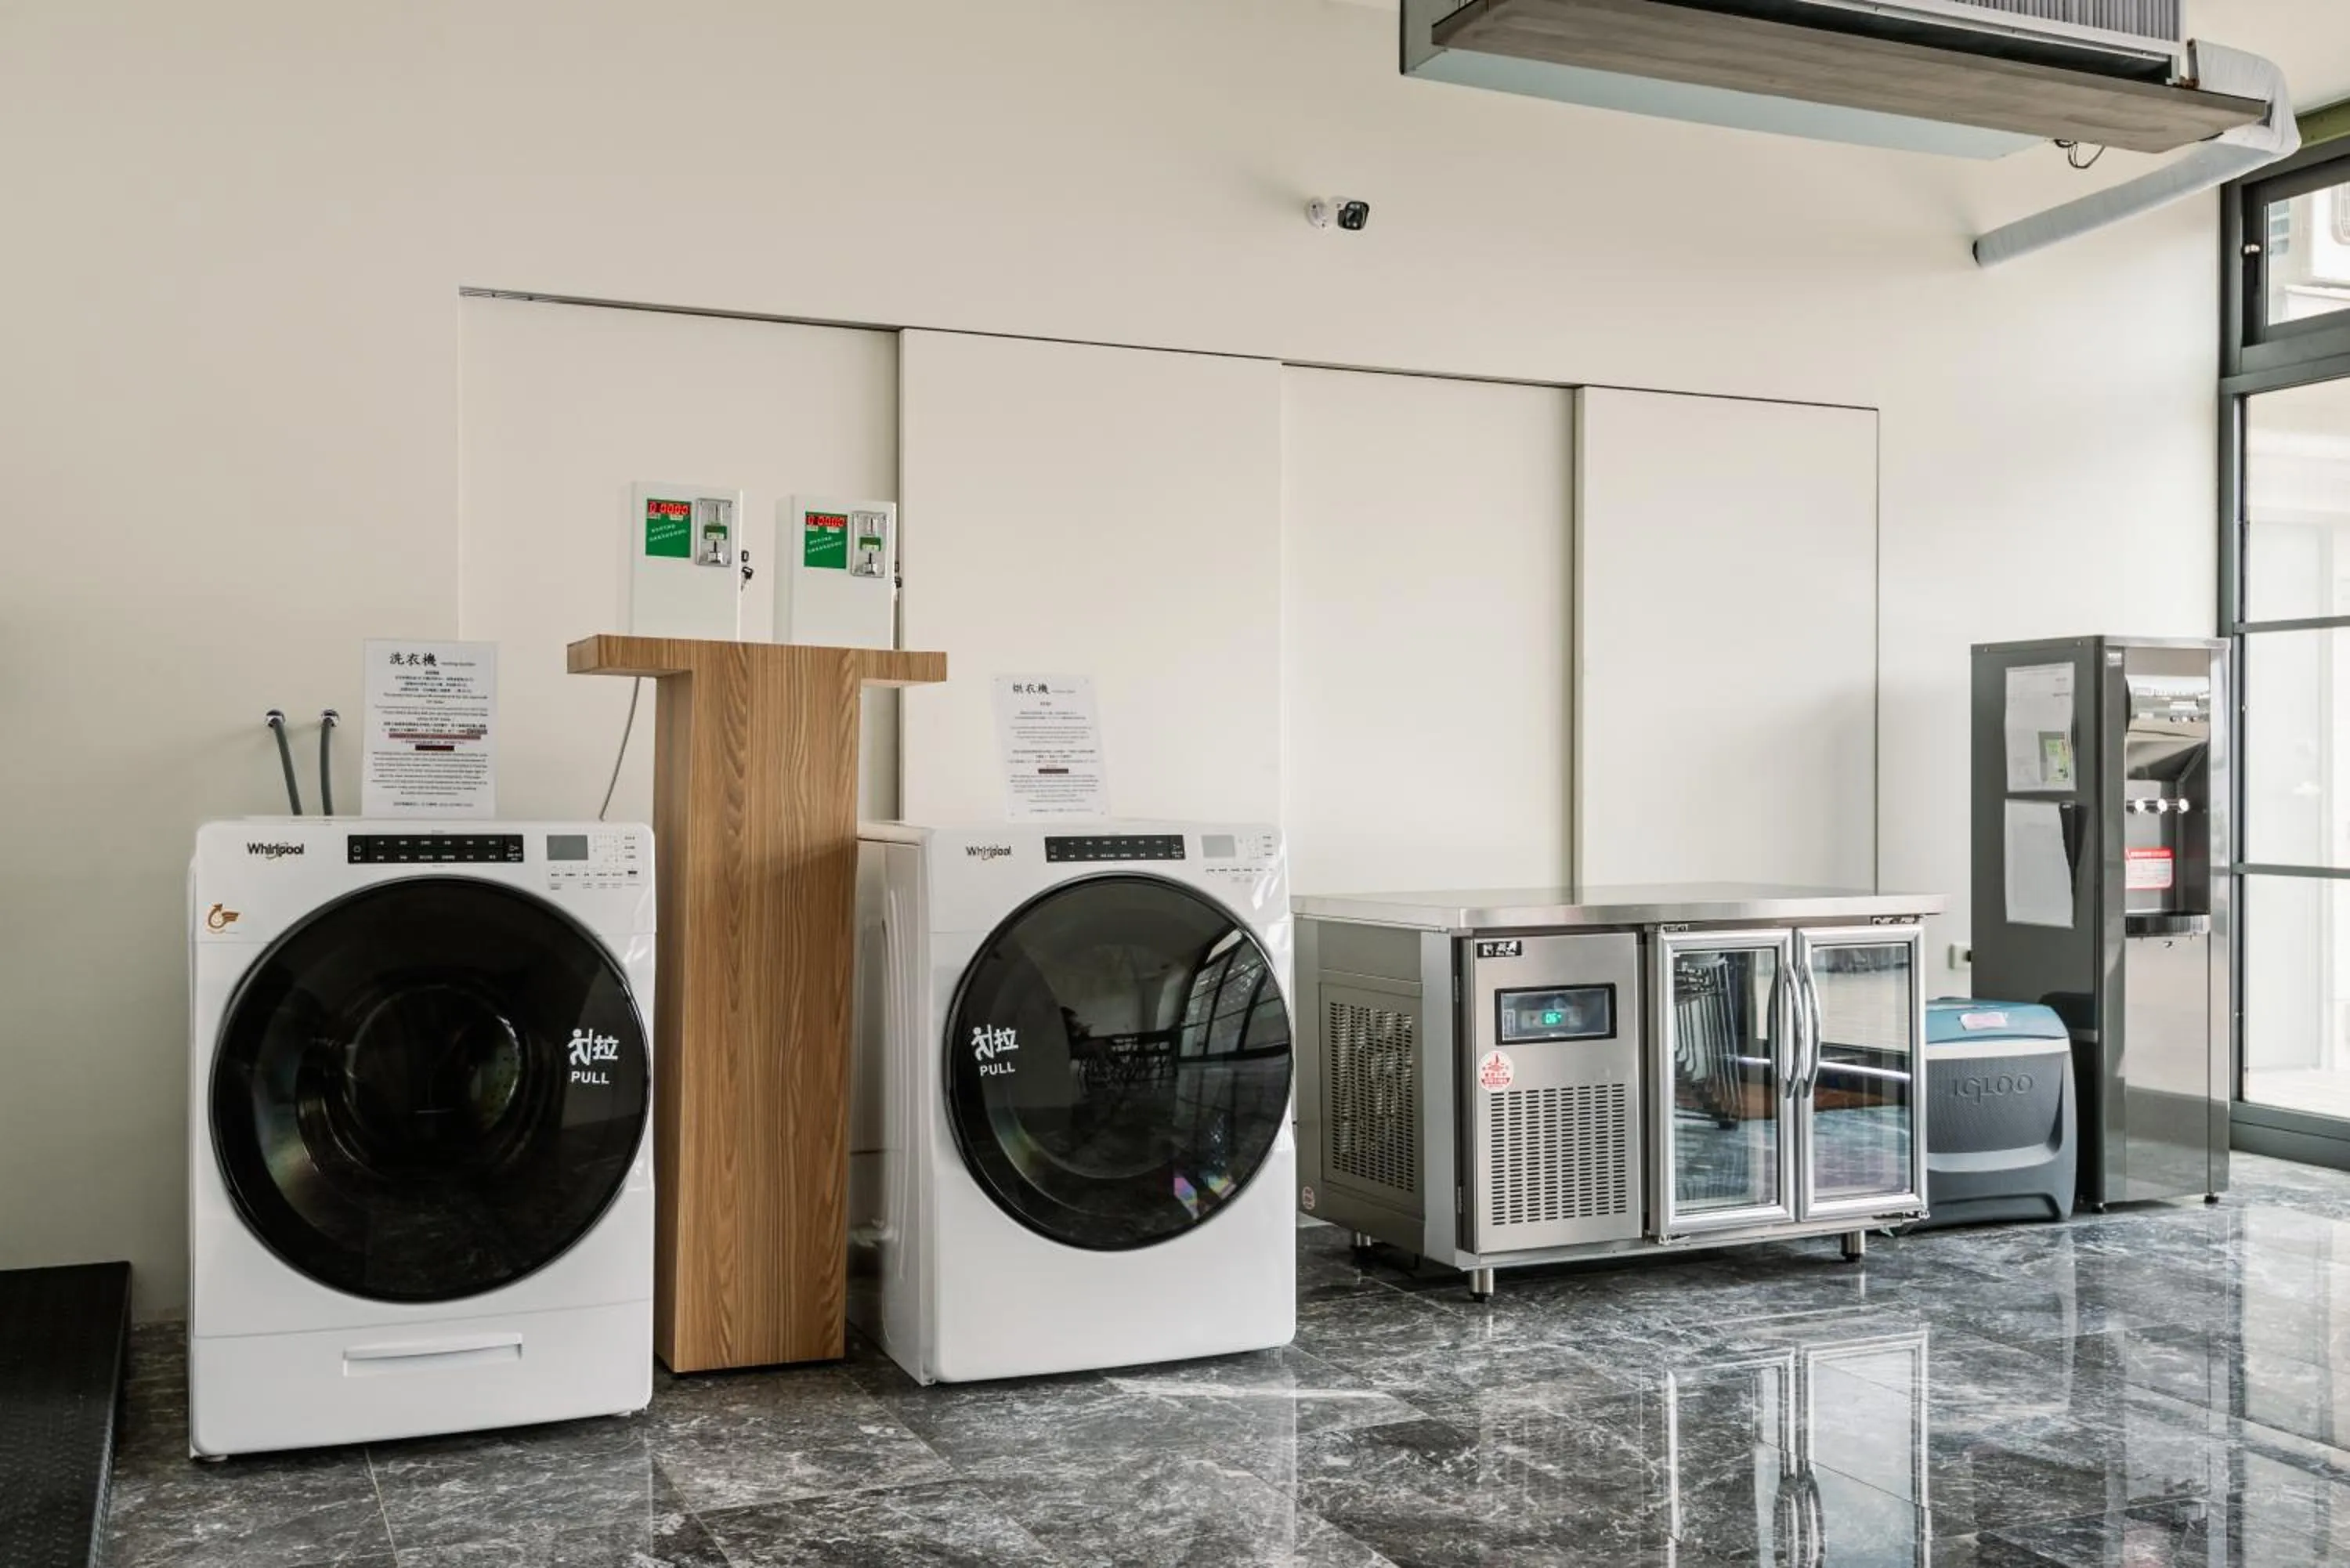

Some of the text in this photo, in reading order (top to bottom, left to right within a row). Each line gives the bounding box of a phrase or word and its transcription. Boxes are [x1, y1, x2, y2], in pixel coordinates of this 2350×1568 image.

[389, 652, 436, 667] 洗衣機
[247, 842, 304, 858] Whirlpool
[966, 846, 1011, 859] Whirlpool
[592, 1035, 620, 1060] 拉
[994, 1028, 1019, 1053] 拉
[979, 1062, 1016, 1077] PULL
[570, 1071, 609, 1084] PULL
